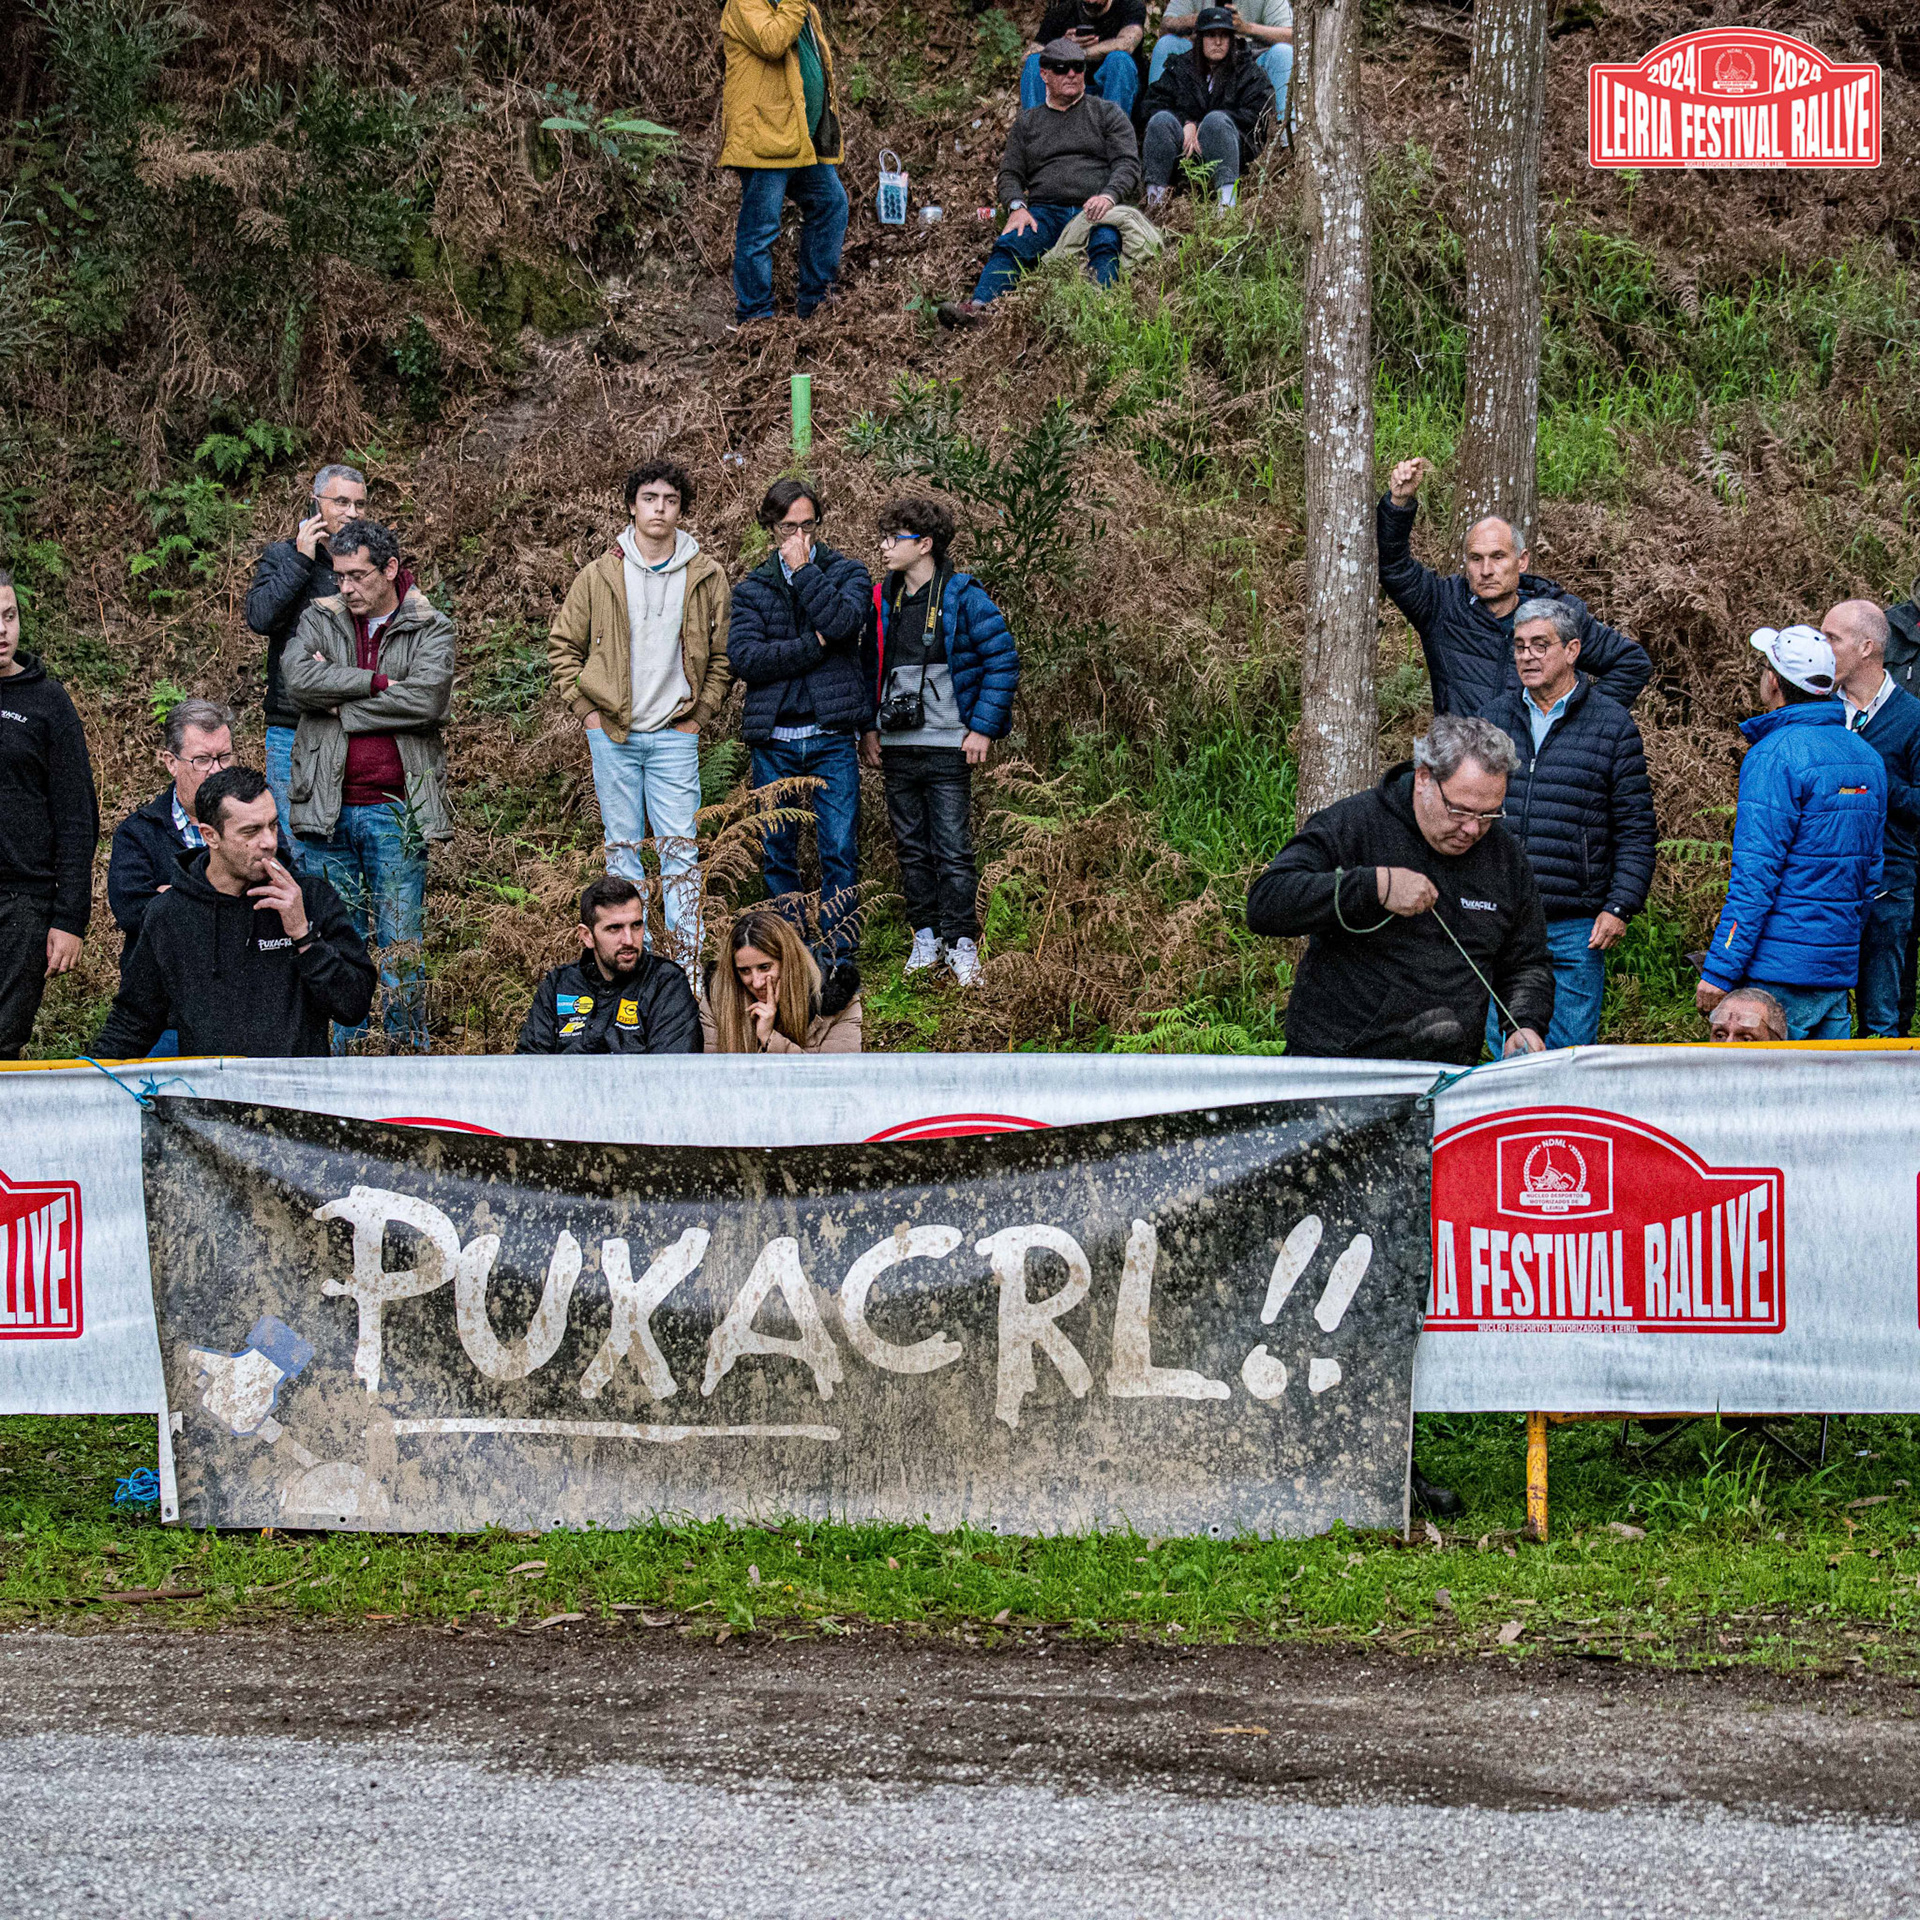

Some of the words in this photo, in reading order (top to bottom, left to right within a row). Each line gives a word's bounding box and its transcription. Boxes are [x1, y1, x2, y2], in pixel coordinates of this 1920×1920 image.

[618, 1015, 638, 1024] OPEL
[1541, 1138, 1566, 1148] NDML
[1470, 1226, 1634, 1317] FESTIVAL
[1644, 1181, 1770, 1318] RALLYE
[1509, 1323, 1550, 1332] DESPORTOS
[1551, 1324, 1603, 1333] MOTORIZADOS
[1604, 1325, 1613, 1333] DE
[1615, 1325, 1638, 1333] LEIRIA
